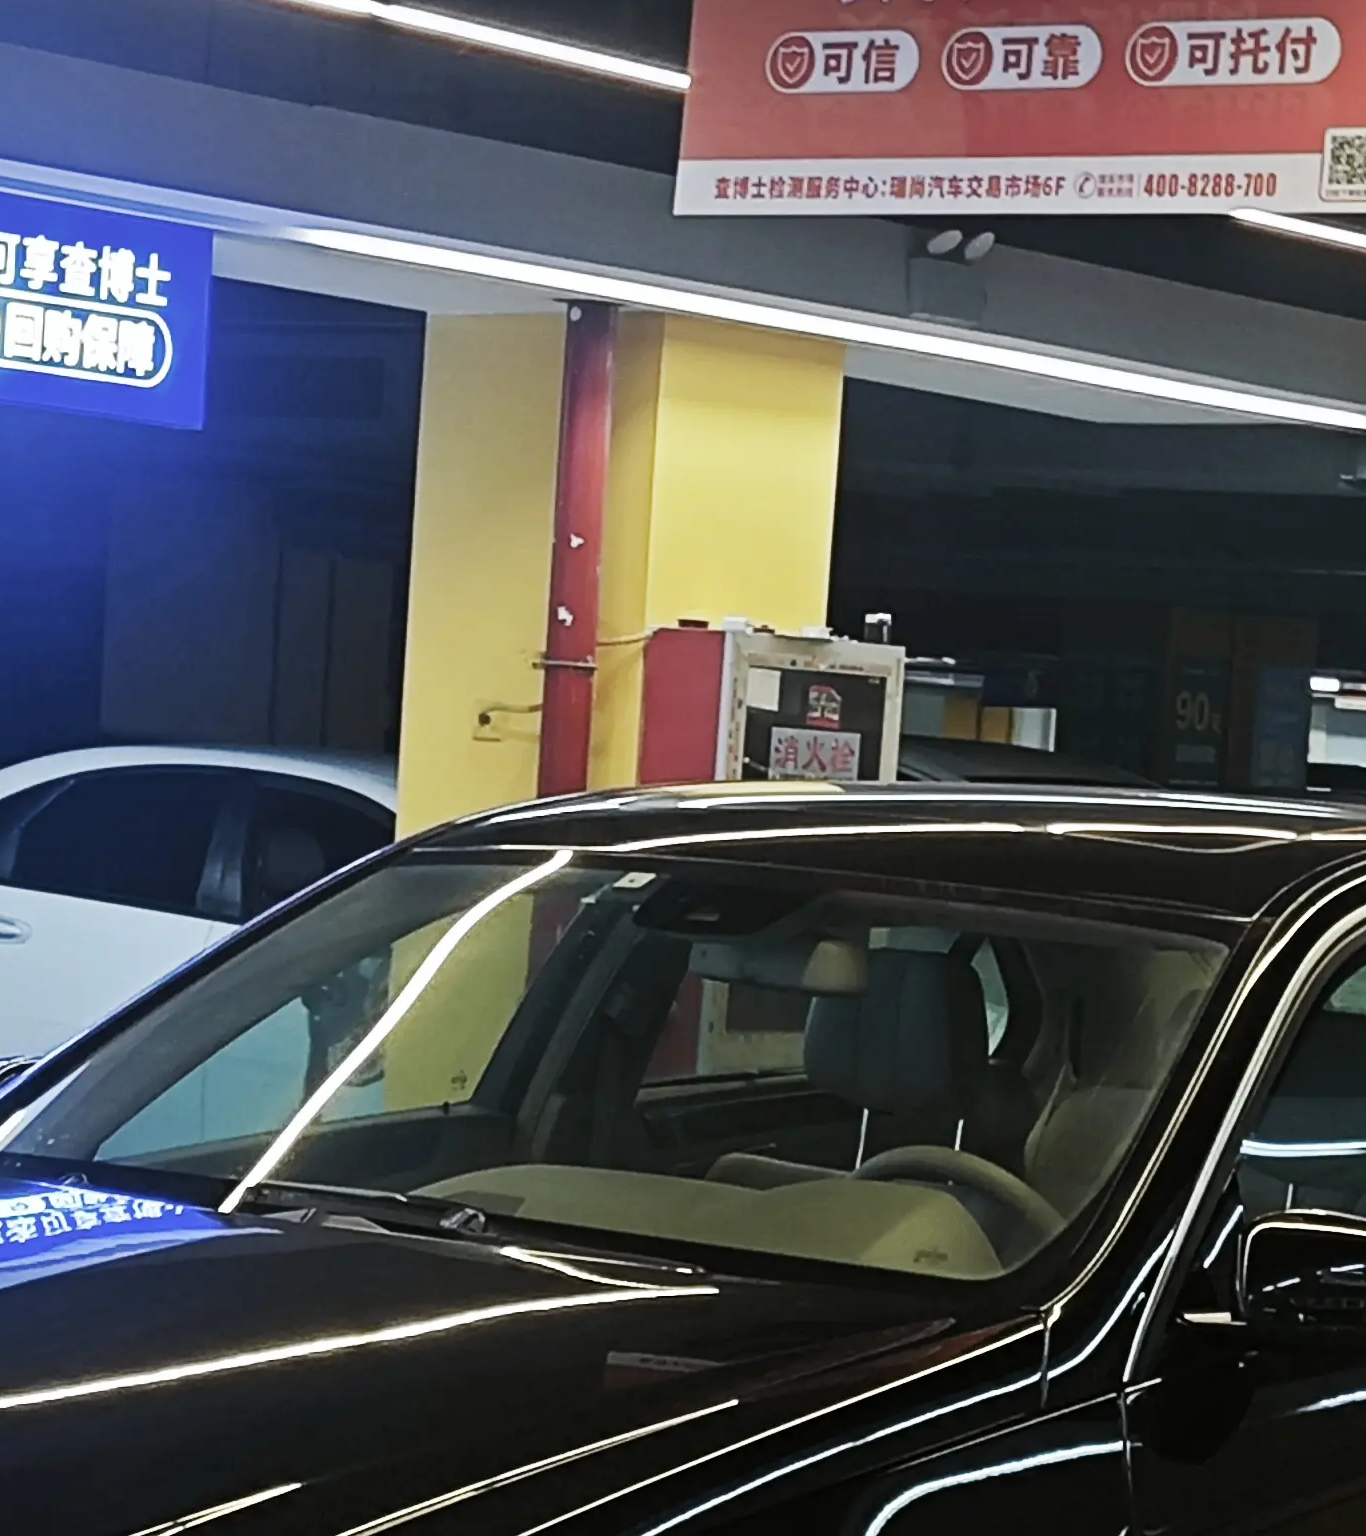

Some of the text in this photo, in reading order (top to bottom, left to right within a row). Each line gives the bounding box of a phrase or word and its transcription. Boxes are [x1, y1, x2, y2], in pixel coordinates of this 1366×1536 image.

[822, 27, 1317, 86] 可信 可靠 可托付
[1144, 172, 1278, 198] 400-8288-700
[2, 308, 156, 377] 回购保障
[774, 735, 856, 773] 消火栓
